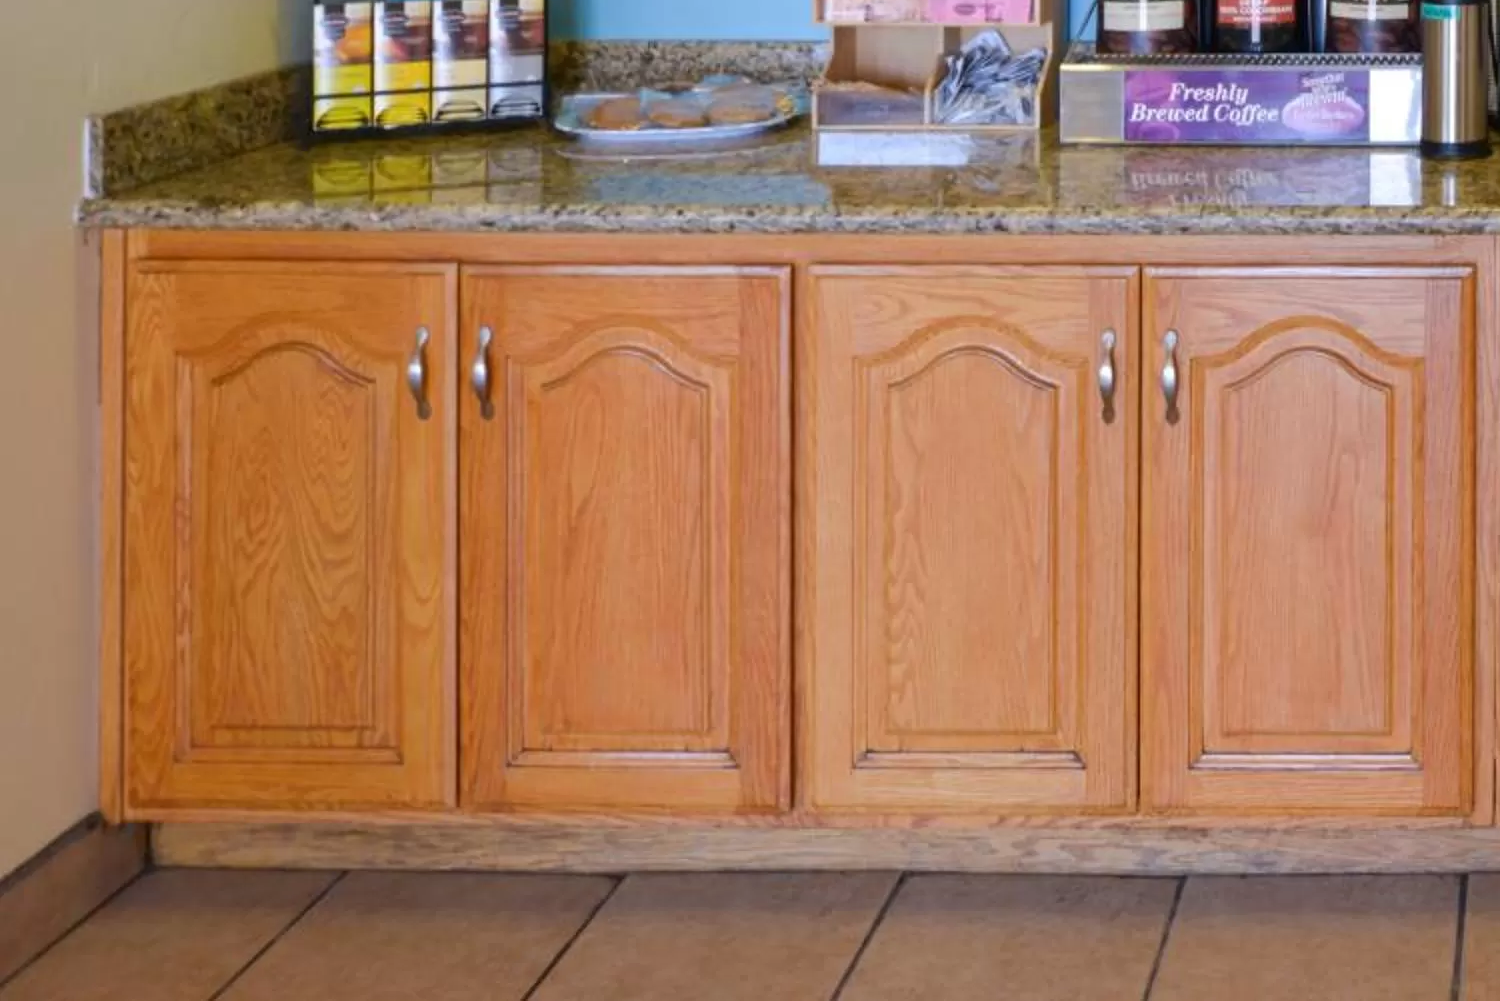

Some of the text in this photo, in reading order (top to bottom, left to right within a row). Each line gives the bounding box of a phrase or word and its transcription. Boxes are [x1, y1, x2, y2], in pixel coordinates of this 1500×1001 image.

[1168, 82, 1249, 105] Freshly
[1130, 102, 1209, 123] Brewed
[1213, 103, 1279, 126] Coffee
